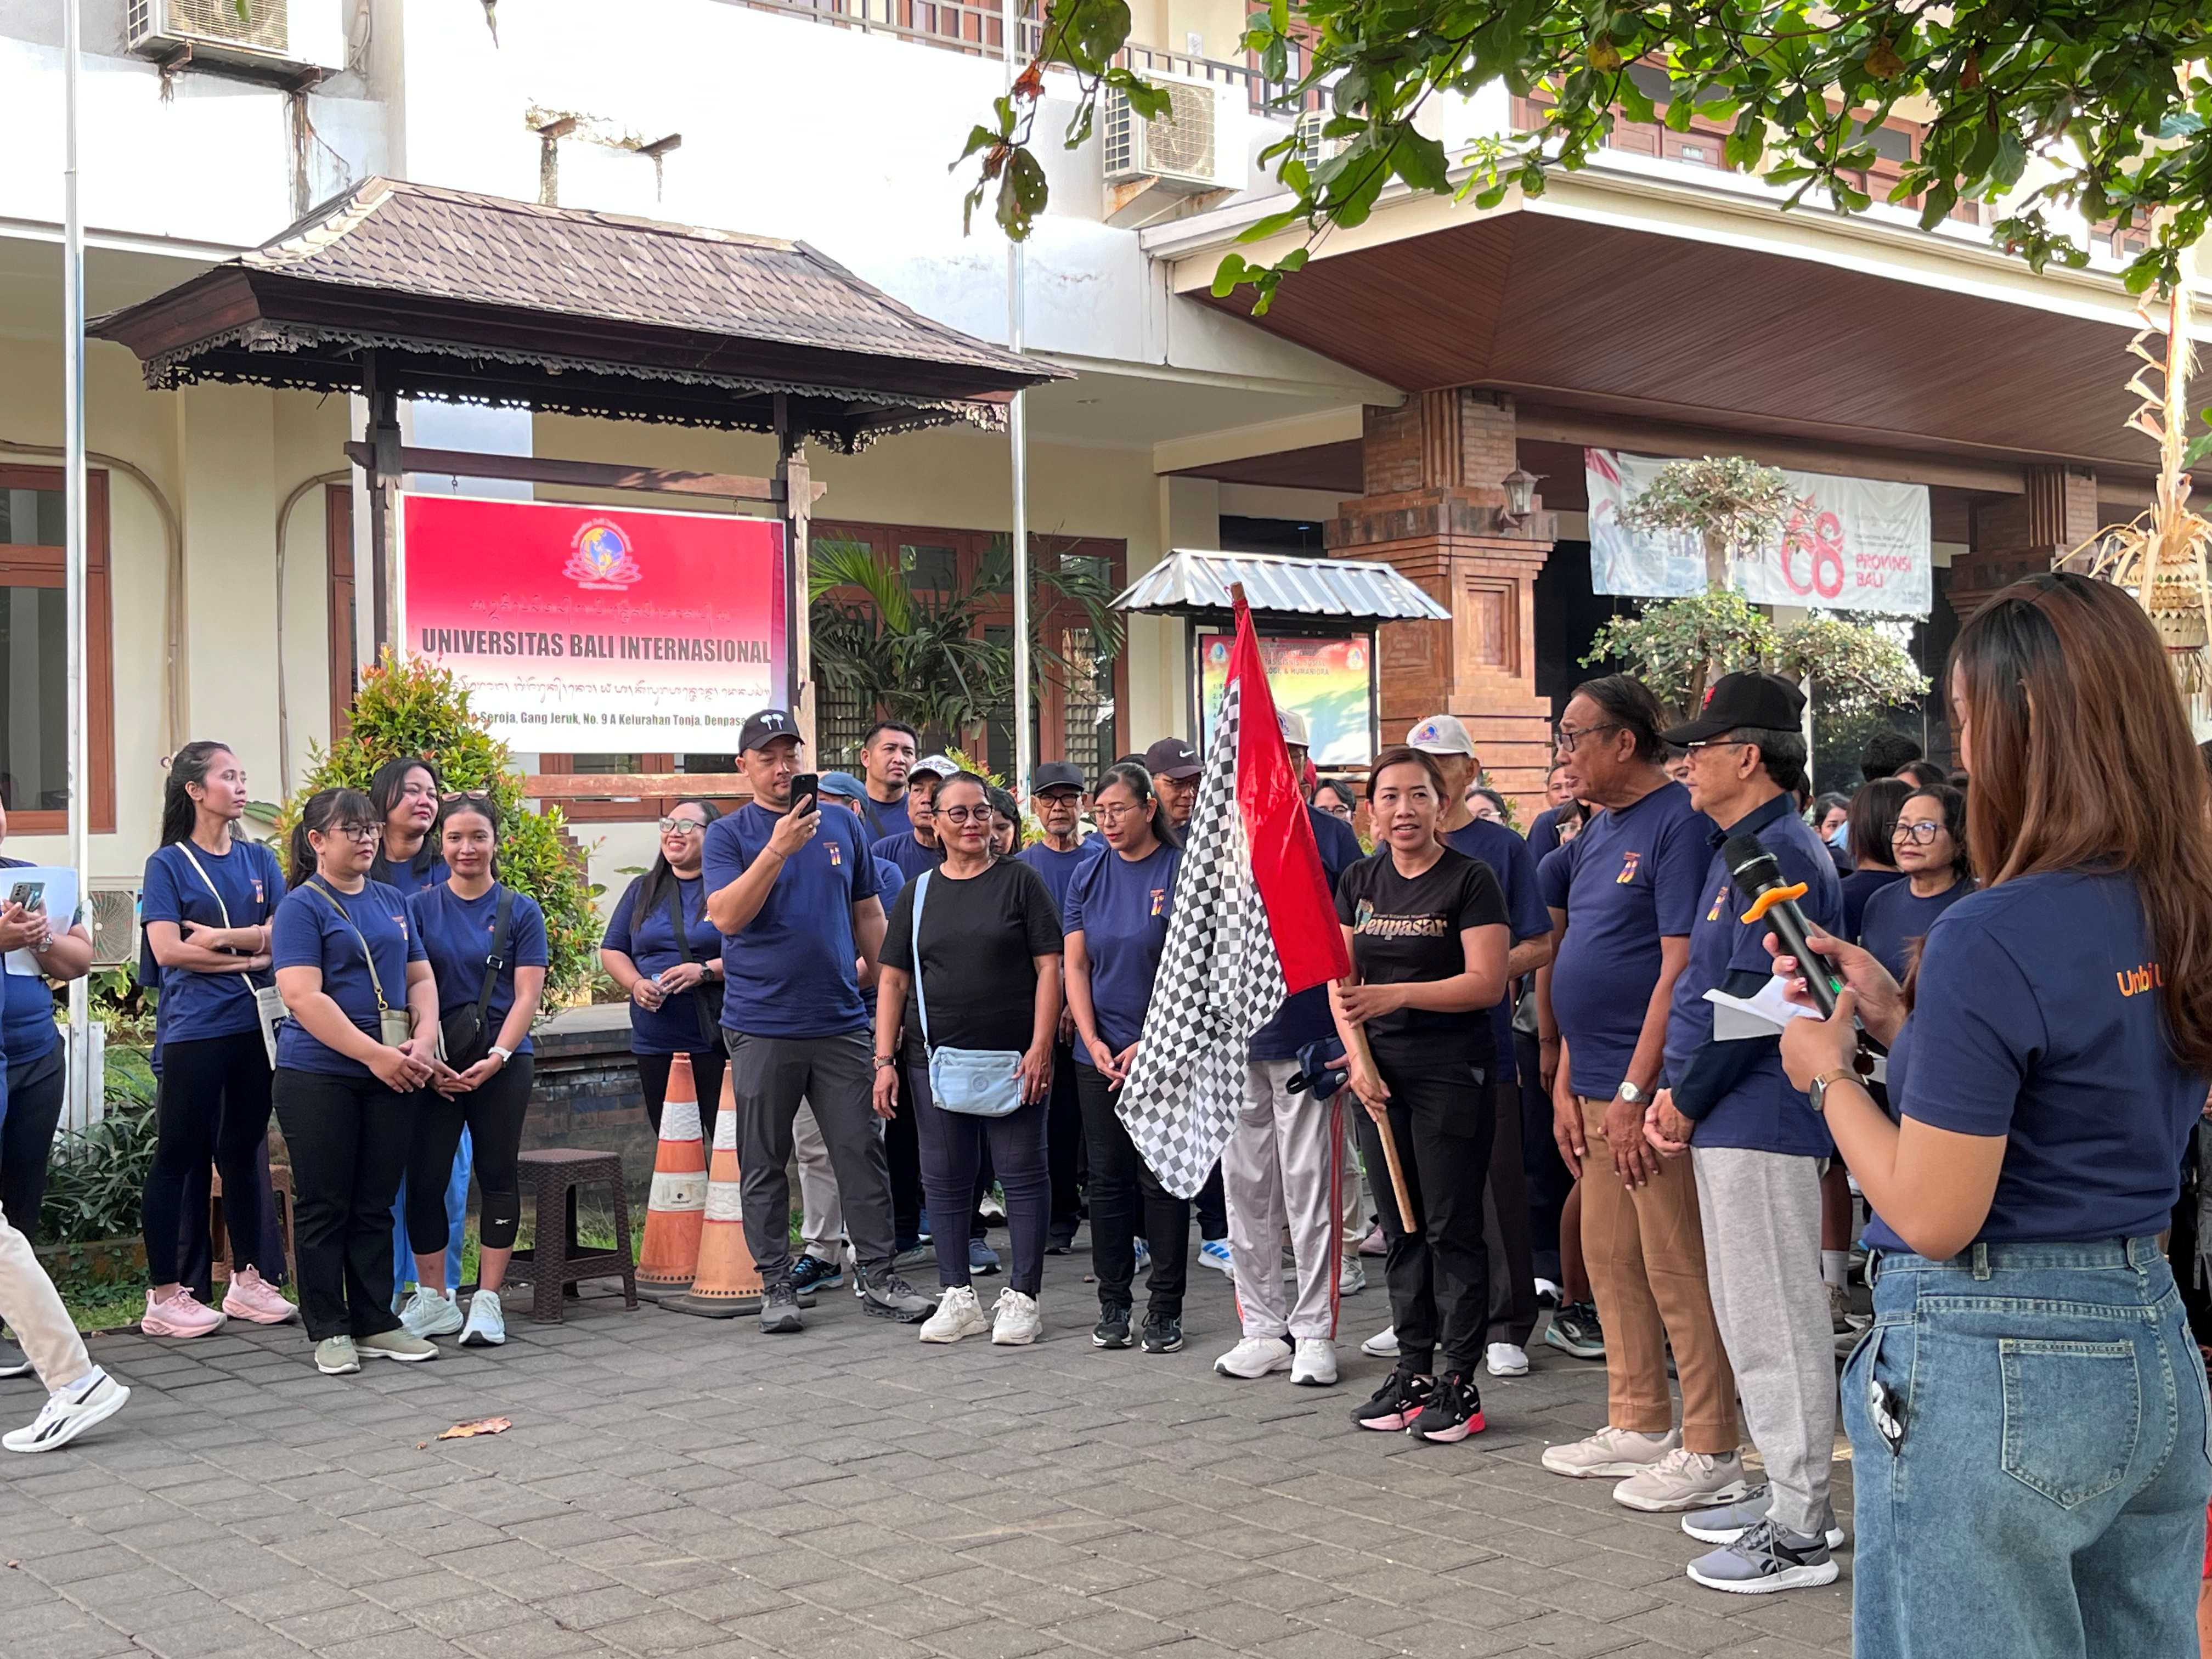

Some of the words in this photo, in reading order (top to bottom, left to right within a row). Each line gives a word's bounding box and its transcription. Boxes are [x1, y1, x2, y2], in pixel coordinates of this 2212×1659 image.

[1855, 553, 1912, 572] PROVINSI
[1855, 572, 1884, 589] BALI
[422, 628, 564, 657] UNIVERSITAS
[570, 634, 614, 658] BALI
[620, 636, 771, 664] INTERNASIONAL
[480, 712, 518, 724] Seroja,
[521, 712, 548, 725] Gang
[550, 712, 581, 725] Jeruk,
[583, 713, 599, 725] No.
[601, 713, 607, 725] 9
[610, 714, 616, 725] A
[619, 714, 670, 725] Kelurahan
[673, 714, 702, 727] Tonja,
[705, 714, 747, 727] Denpasa
[1353, 898, 1448, 941] Denpasar
[2117, 962, 2153, 997] Unbi
